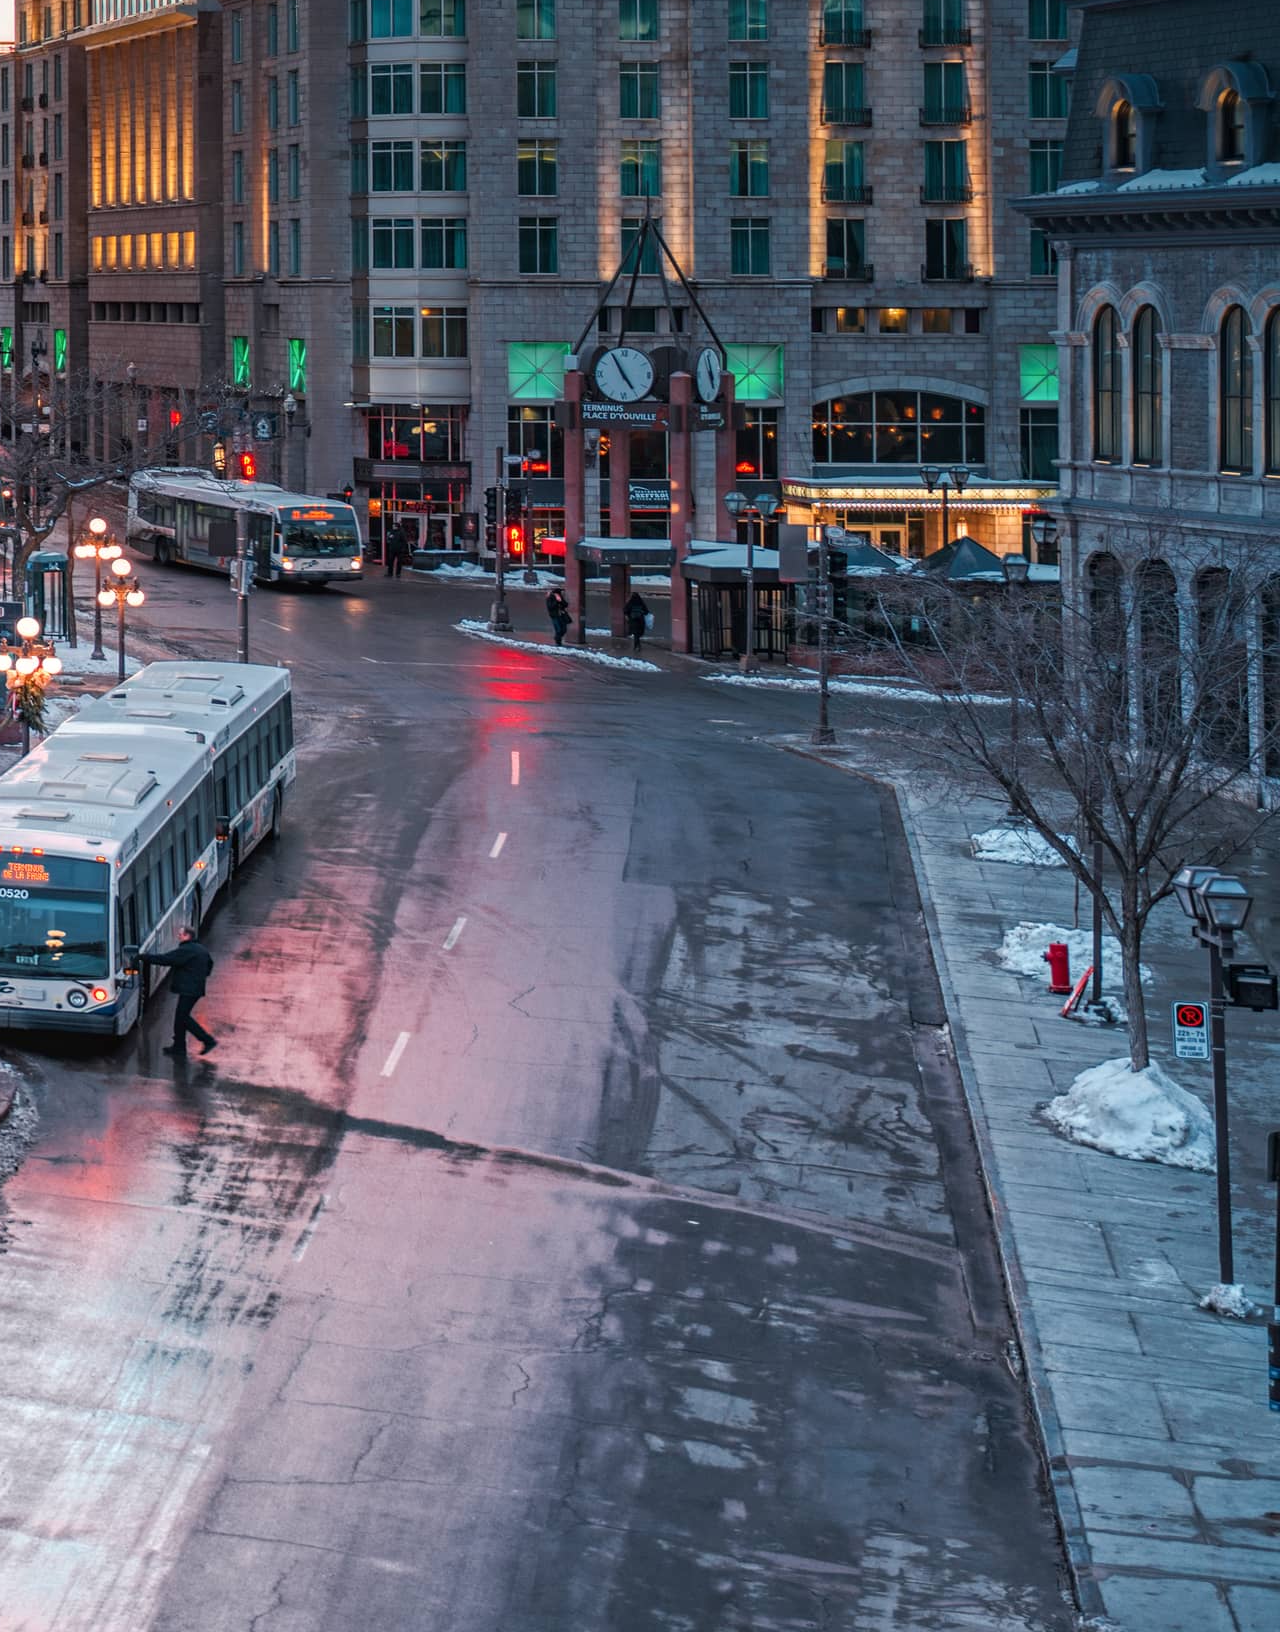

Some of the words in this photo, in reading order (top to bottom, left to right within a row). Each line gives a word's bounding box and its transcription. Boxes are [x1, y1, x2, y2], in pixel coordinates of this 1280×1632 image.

[583, 404, 624, 412] TERMINUS
[610, 413, 656, 421] D'YOUVILLE
[7, 862, 45, 873] TERMINUS
[2, 869, 13, 879] DE
[15, 871, 25, 880] LA
